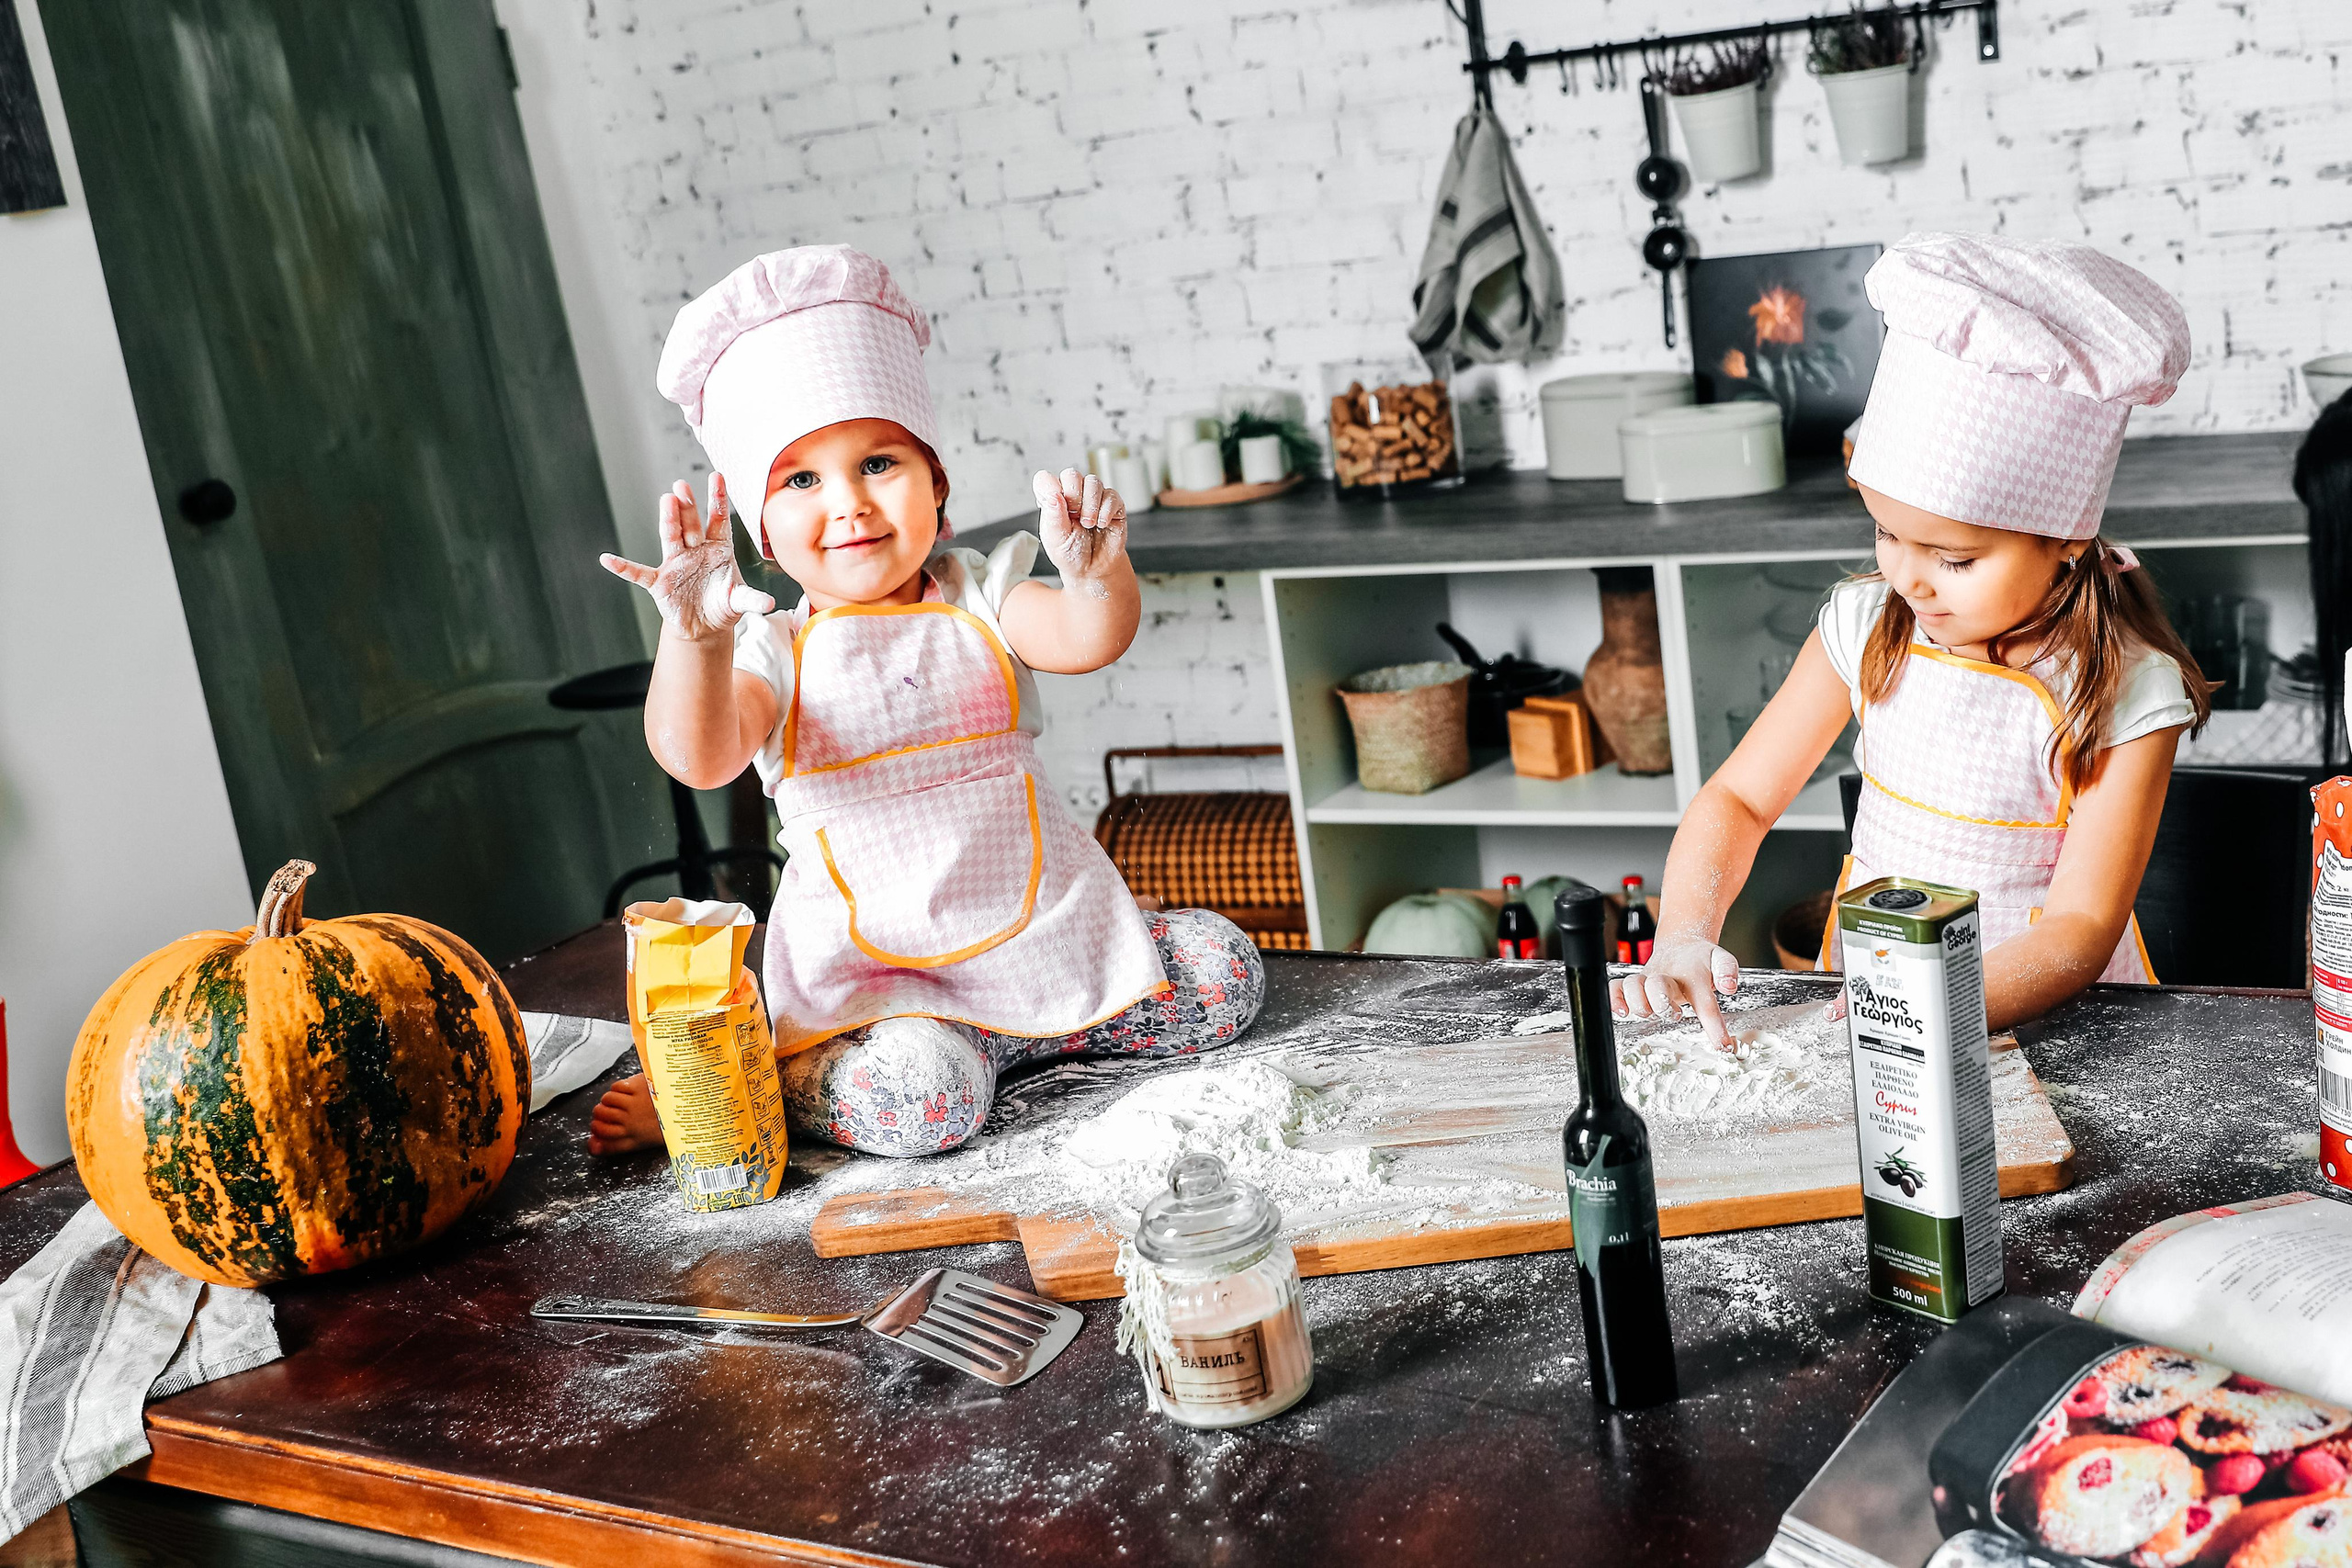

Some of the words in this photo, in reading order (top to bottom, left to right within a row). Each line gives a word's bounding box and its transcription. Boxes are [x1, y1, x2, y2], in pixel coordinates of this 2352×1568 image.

[1947, 931, 1977, 951] George
[2325, 1031, 2344, 1045] ГРЕЙН
[1875, 1070, 1915, 1088] ΠΑΡΘΕΝΟ
[1875, 1090, 1917, 1116] Cyprus
[1869, 1111, 1895, 1126] EXTRA
[1897, 1119, 1926, 1134] VIRGIN
[1878, 1123, 1903, 1137] OLIVE
[1904, 1131, 1917, 1142] OIL
[1566, 1168, 1617, 1190] Brachia
[1893, 1285, 1913, 1302] 500
[1914, 1294, 1928, 1307] ml
[1181, 1350, 1245, 1369] ВАНИЛЬ
